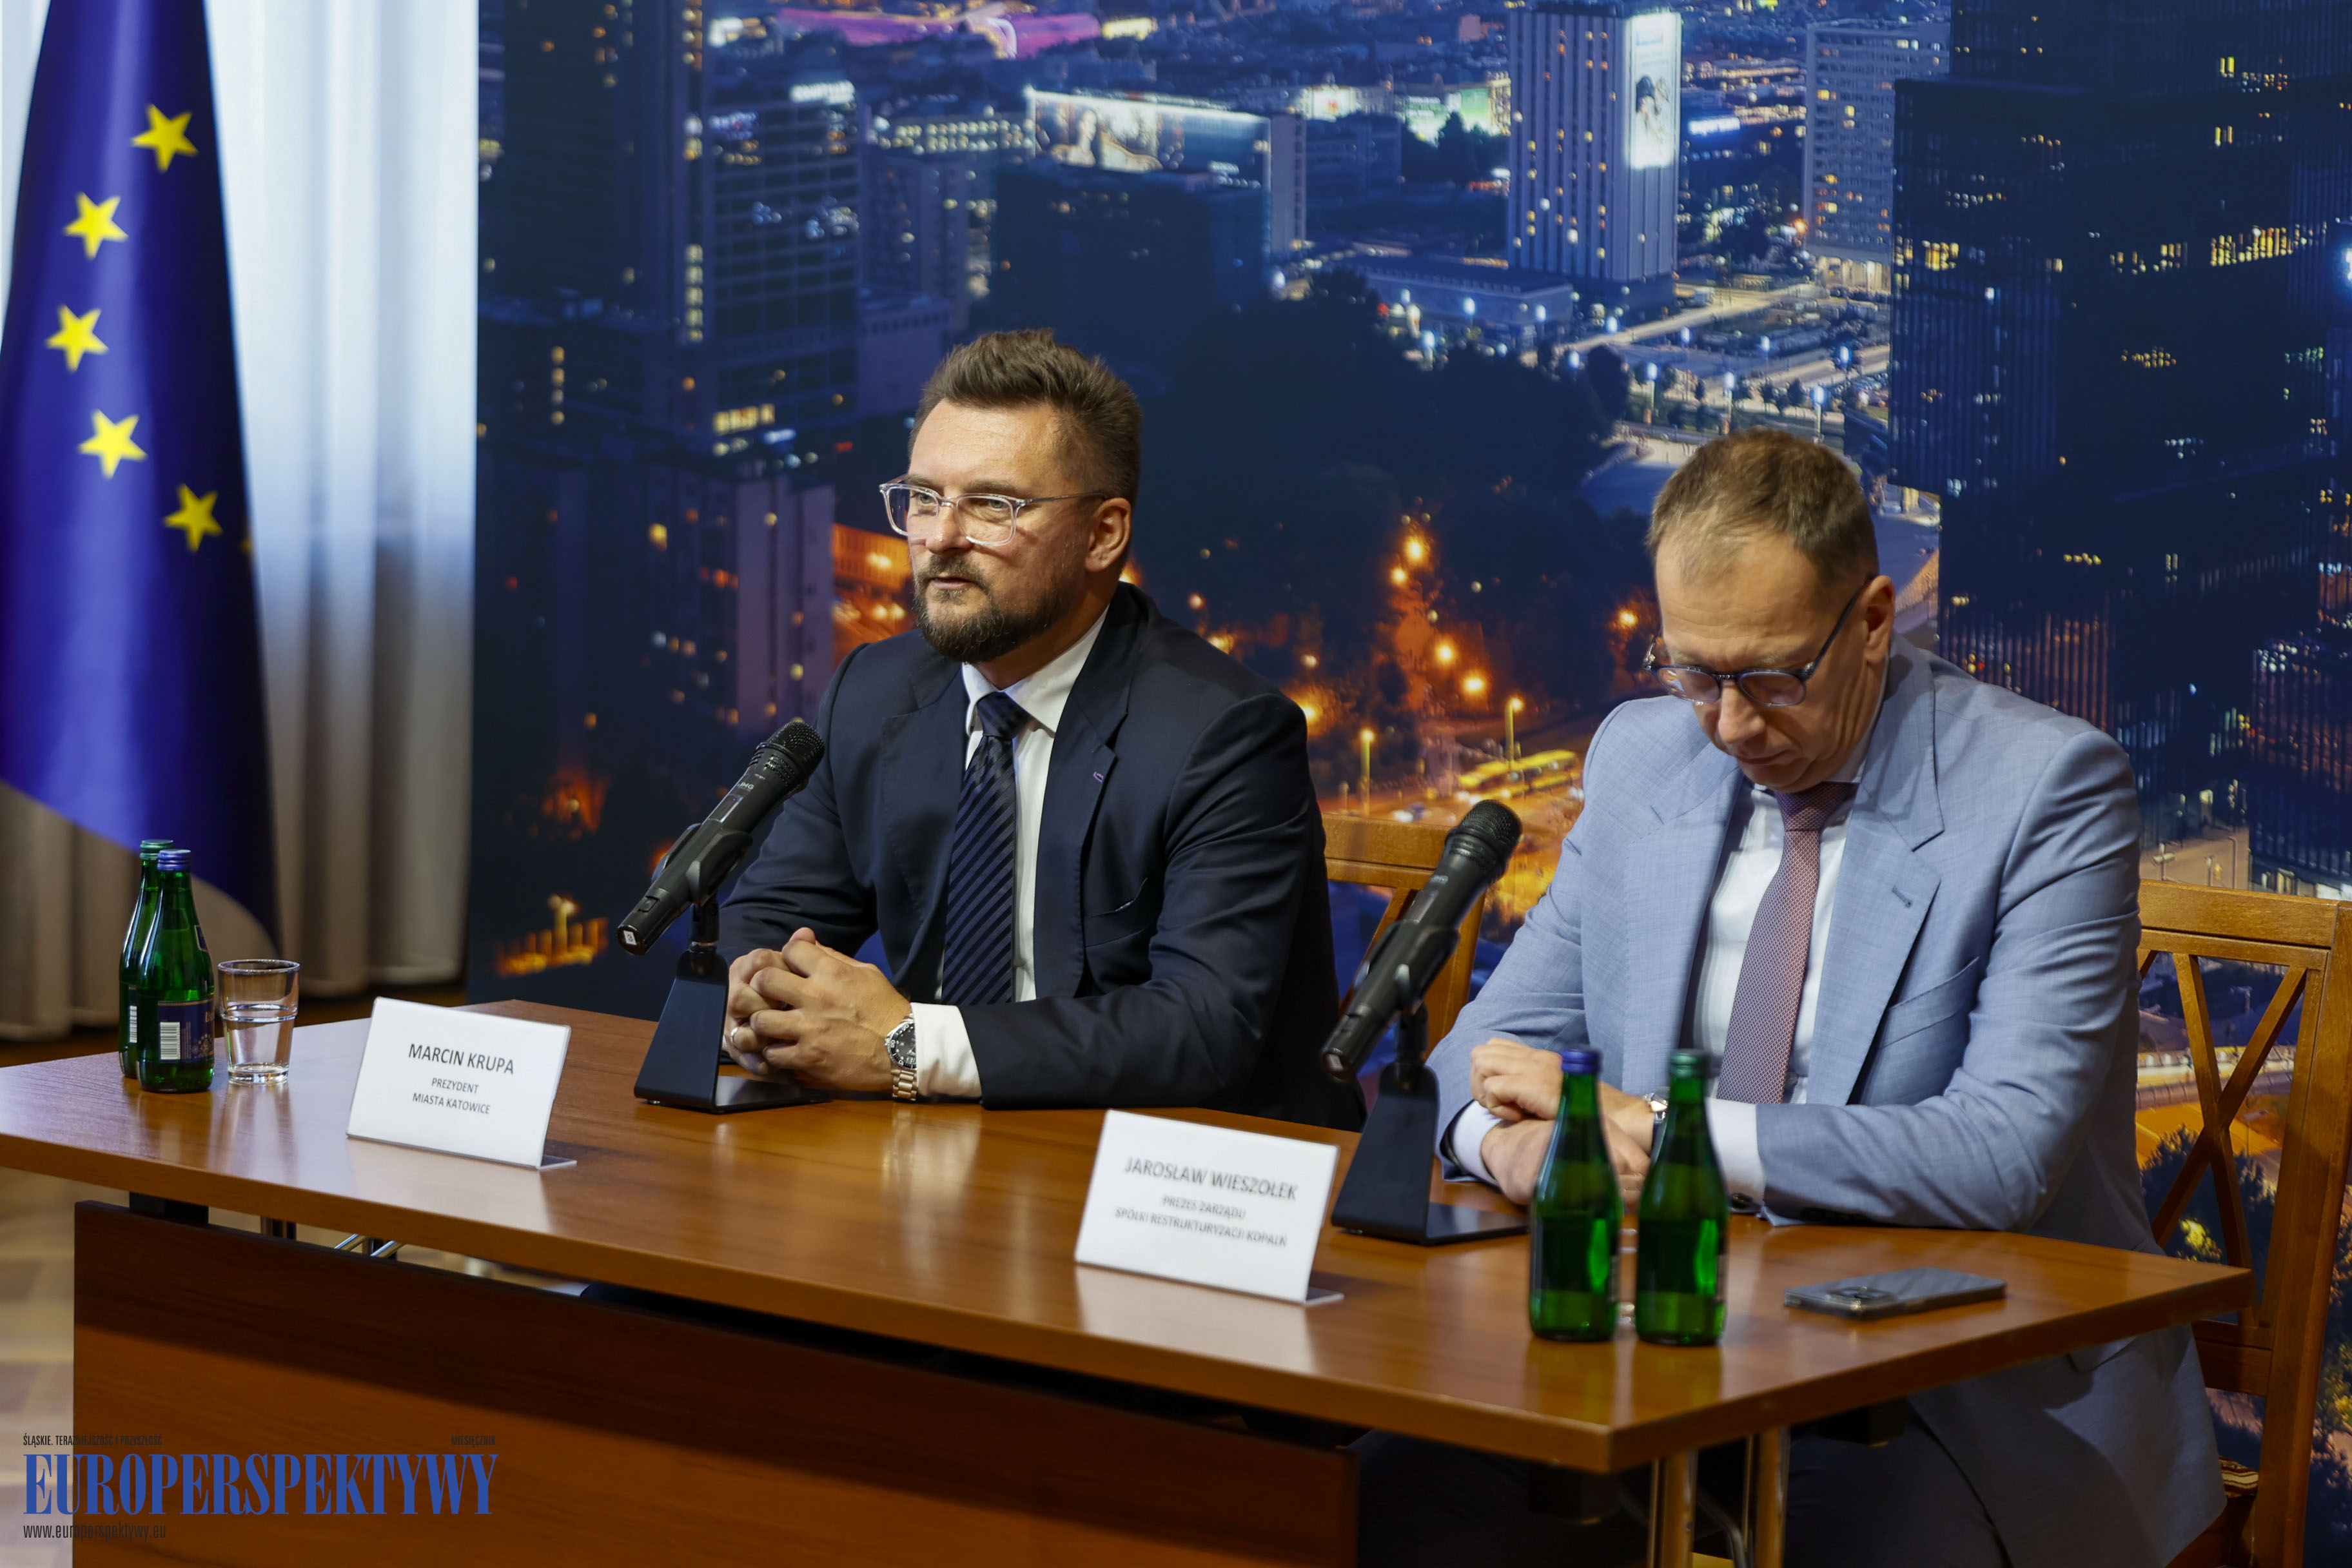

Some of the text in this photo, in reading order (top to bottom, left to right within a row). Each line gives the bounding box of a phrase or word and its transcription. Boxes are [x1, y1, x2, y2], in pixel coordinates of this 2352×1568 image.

[408, 1043, 514, 1075] MARCIN KRUPA
[431, 1077, 479, 1094] PREZYDENT
[413, 1093, 491, 1115] MIASTA KATOWICE
[1124, 1156, 1298, 1201] JAROSŁAW WIESZOŁEK
[1162, 1195, 1247, 1220] PREZES ZARZĄDU
[1151, 1212, 1245, 1240] RESTRUKTURYZACJI
